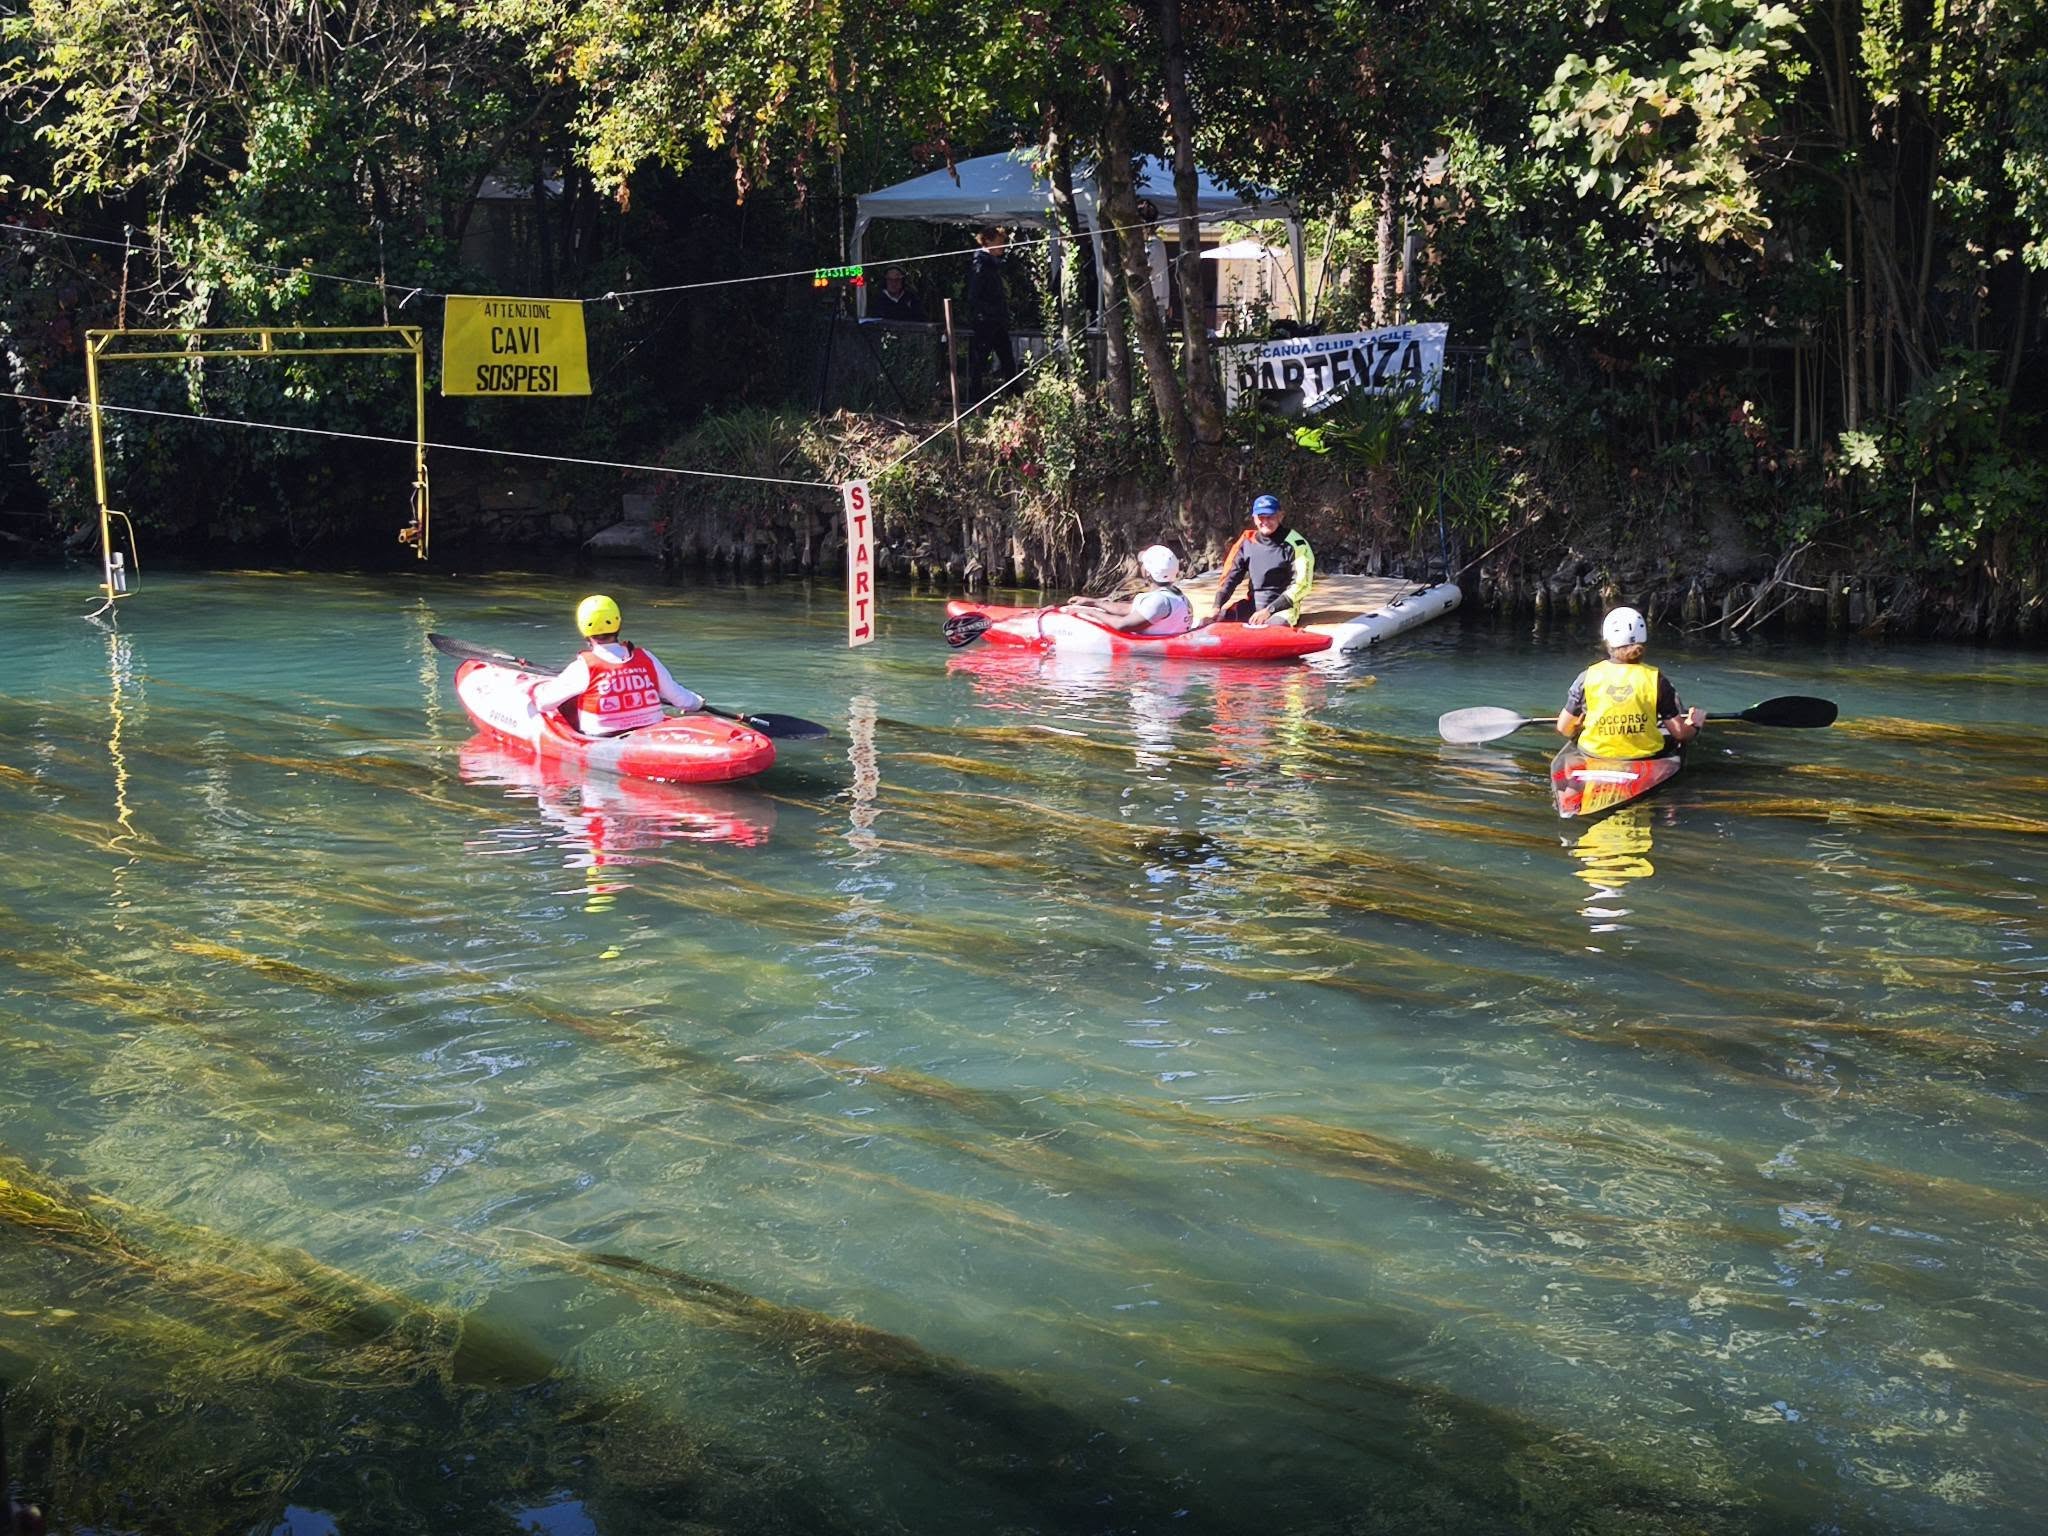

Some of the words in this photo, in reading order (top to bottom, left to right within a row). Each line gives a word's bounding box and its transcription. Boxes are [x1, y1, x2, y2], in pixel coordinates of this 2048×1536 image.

[484, 302, 552, 320] ATTENZIONE
[491, 326, 540, 355] CAVI
[1263, 344, 1311, 359] CANOA
[476, 364, 559, 392] SOSPESI
[851, 486, 870, 621] START
[597, 674, 655, 695] GUIDA
[1598, 723, 1646, 736] FLUVIALE
